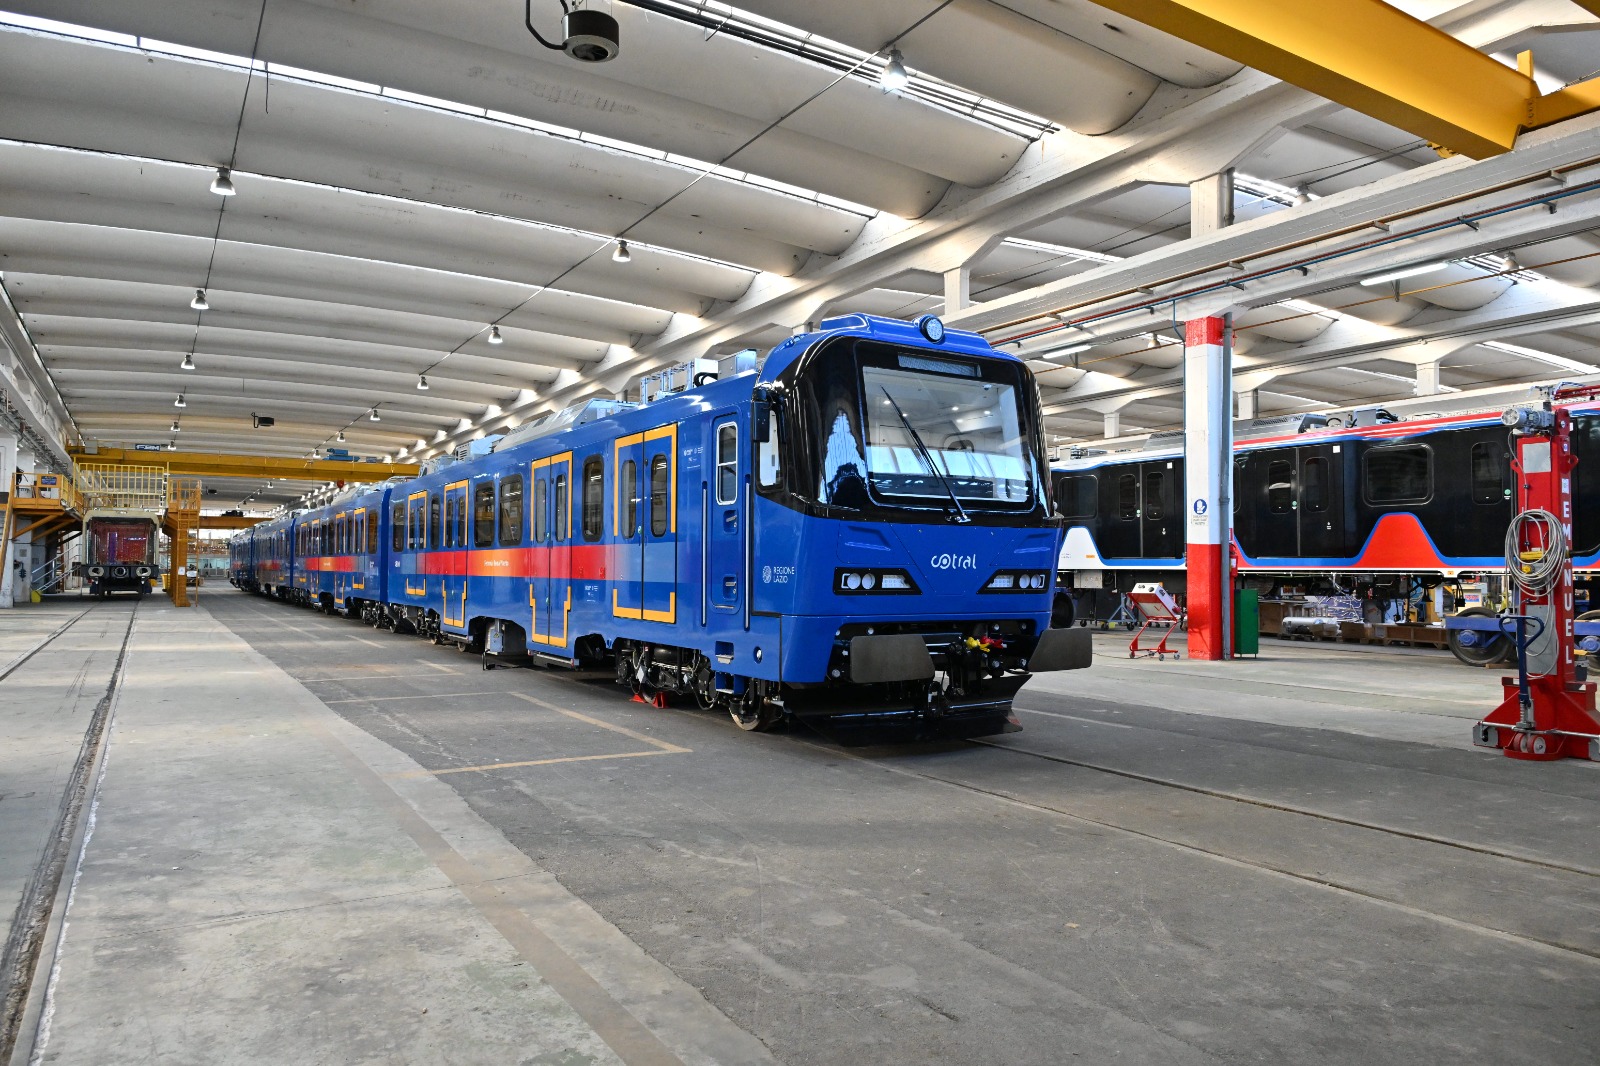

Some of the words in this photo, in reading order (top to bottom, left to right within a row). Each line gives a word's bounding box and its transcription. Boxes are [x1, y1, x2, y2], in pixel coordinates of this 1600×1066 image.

[930, 553, 977, 570] cotral
[773, 566, 795, 575] REGIONE
[773, 575, 789, 584] LAZIO
[1562, 501, 1573, 665] EMANUEL
